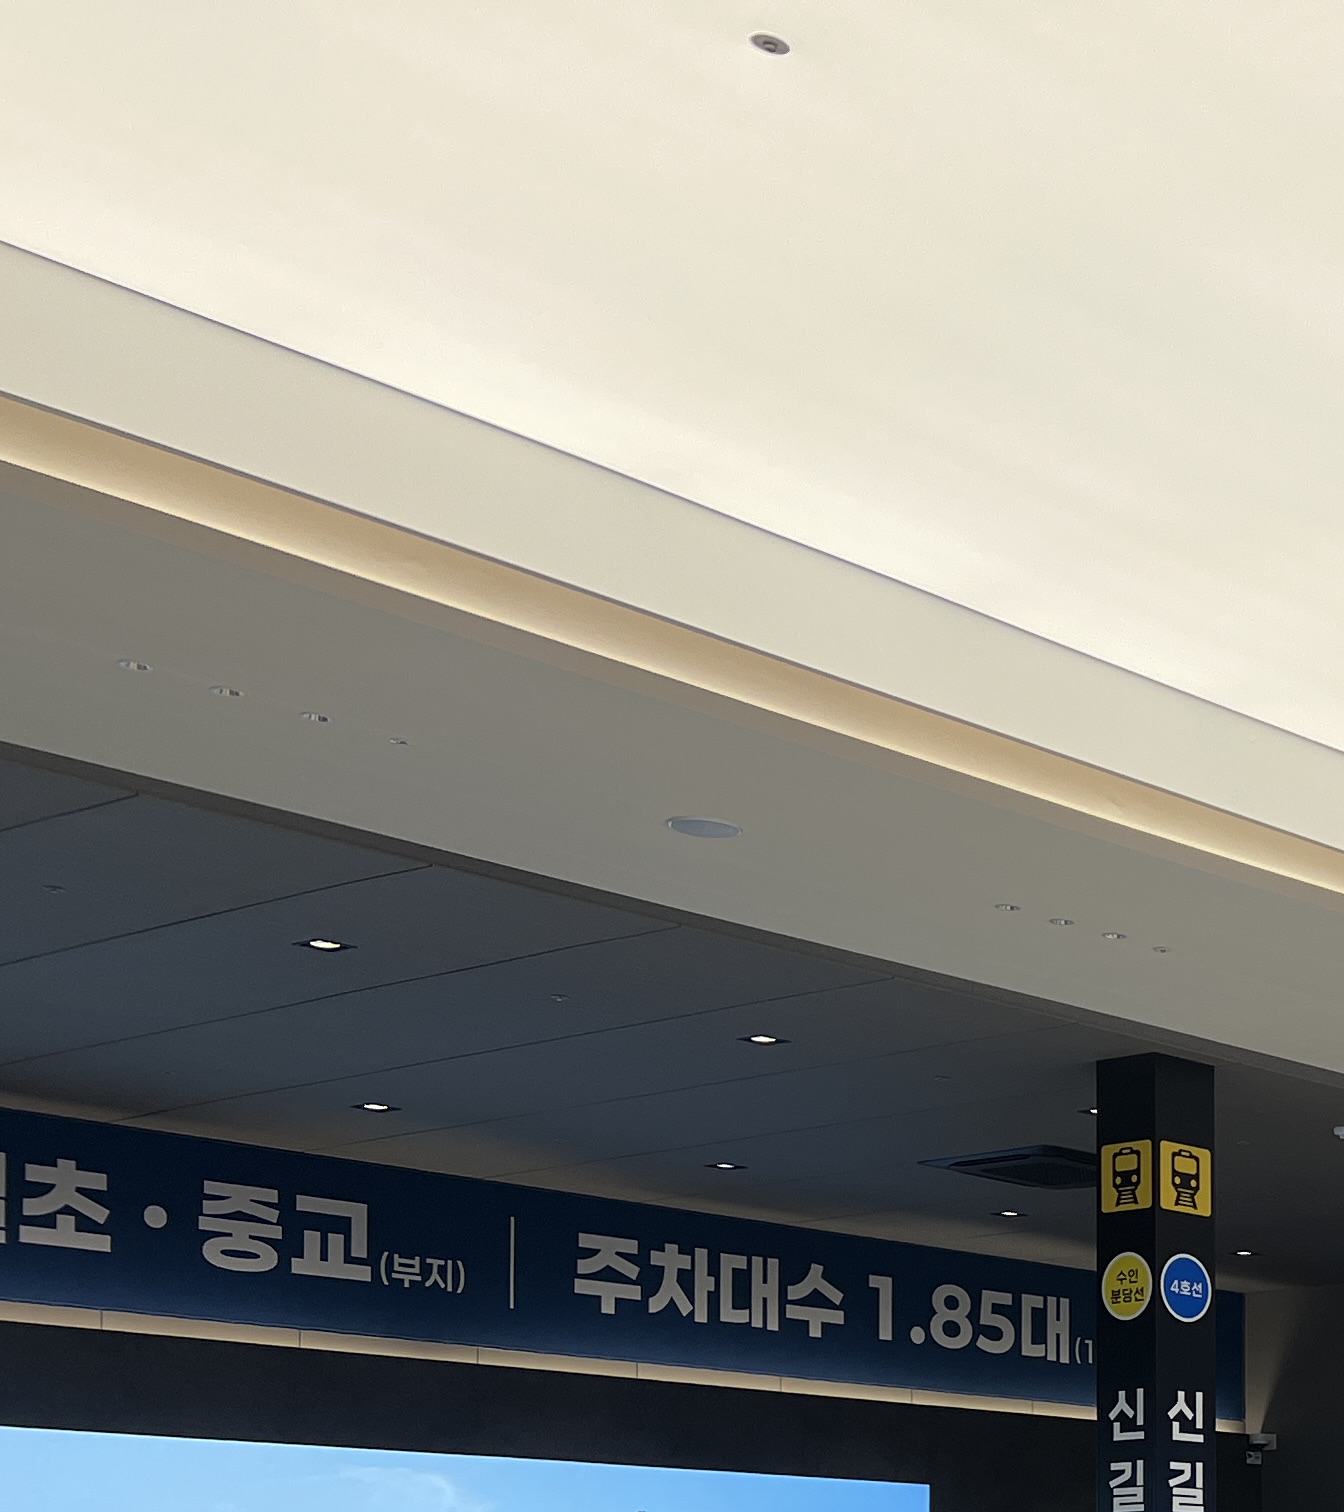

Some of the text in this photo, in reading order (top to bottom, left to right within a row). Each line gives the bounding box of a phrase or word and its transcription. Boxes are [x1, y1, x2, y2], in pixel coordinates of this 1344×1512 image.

[0, 1152, 112, 1253] 초
[574, 1232, 845, 1338] 주차대수
[1116, 1268, 1139, 1285] 수인
[1110, 1287, 1145, 1304] 분당선
[1170, 1279, 1203, 1298] 4호선
